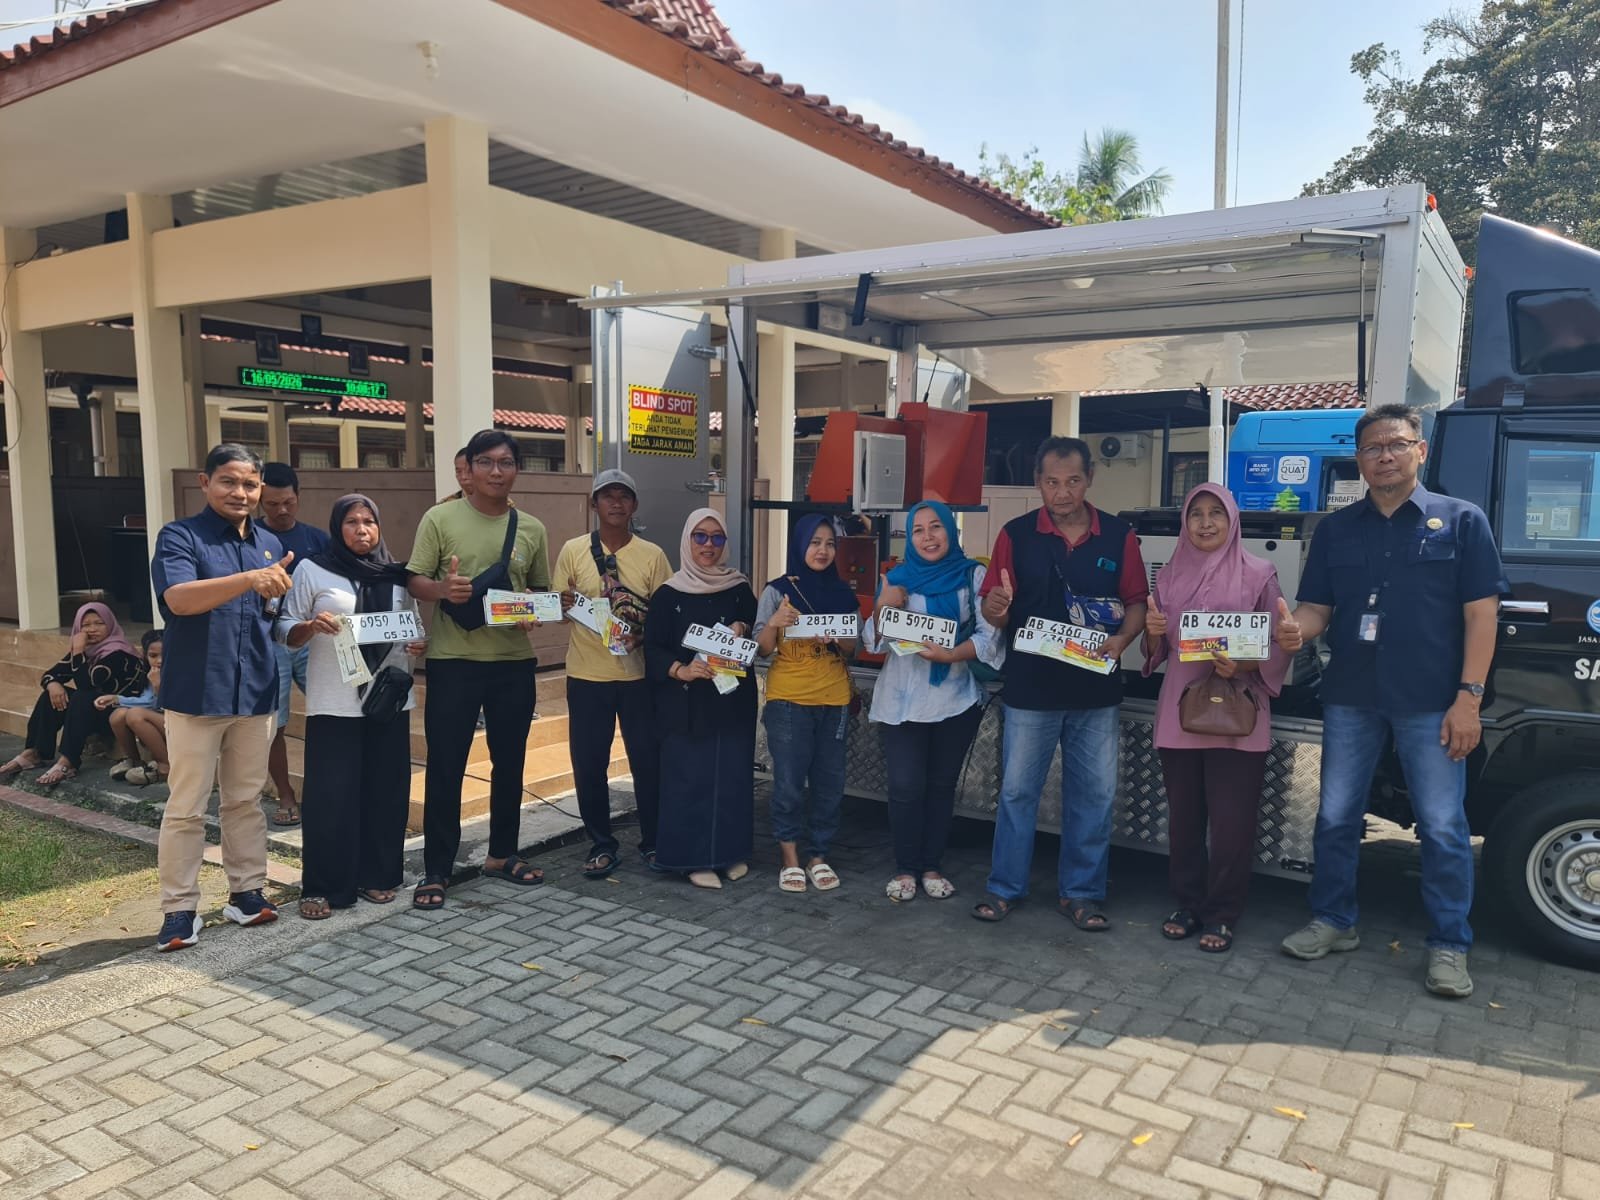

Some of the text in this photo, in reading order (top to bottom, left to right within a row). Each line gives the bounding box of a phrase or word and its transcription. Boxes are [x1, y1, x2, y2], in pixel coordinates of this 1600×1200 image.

[632, 392, 693, 413] BLIND SPOT
[646, 413, 682, 426] ANDA TIDAK
[631, 422, 660, 433] TERLIHAT
[633, 437, 693, 451] JAGA JARAK AMAN
[360, 615, 389, 628] 6959
[398, 613, 414, 626] AK
[807, 616, 834, 625] 2817
[842, 615, 856, 625] GP
[885, 610, 899, 623] AB
[906, 614, 934, 630] 5970
[1182, 615, 1268, 629] AB 4248 GP
[1018, 630, 1034, 639] AB
[1028, 618, 1044, 630] AB
[1050, 623, 1082, 639] 4360
[688, 625, 756, 652] AB 2766 GP
[1201, 640, 1220, 650] 10%
